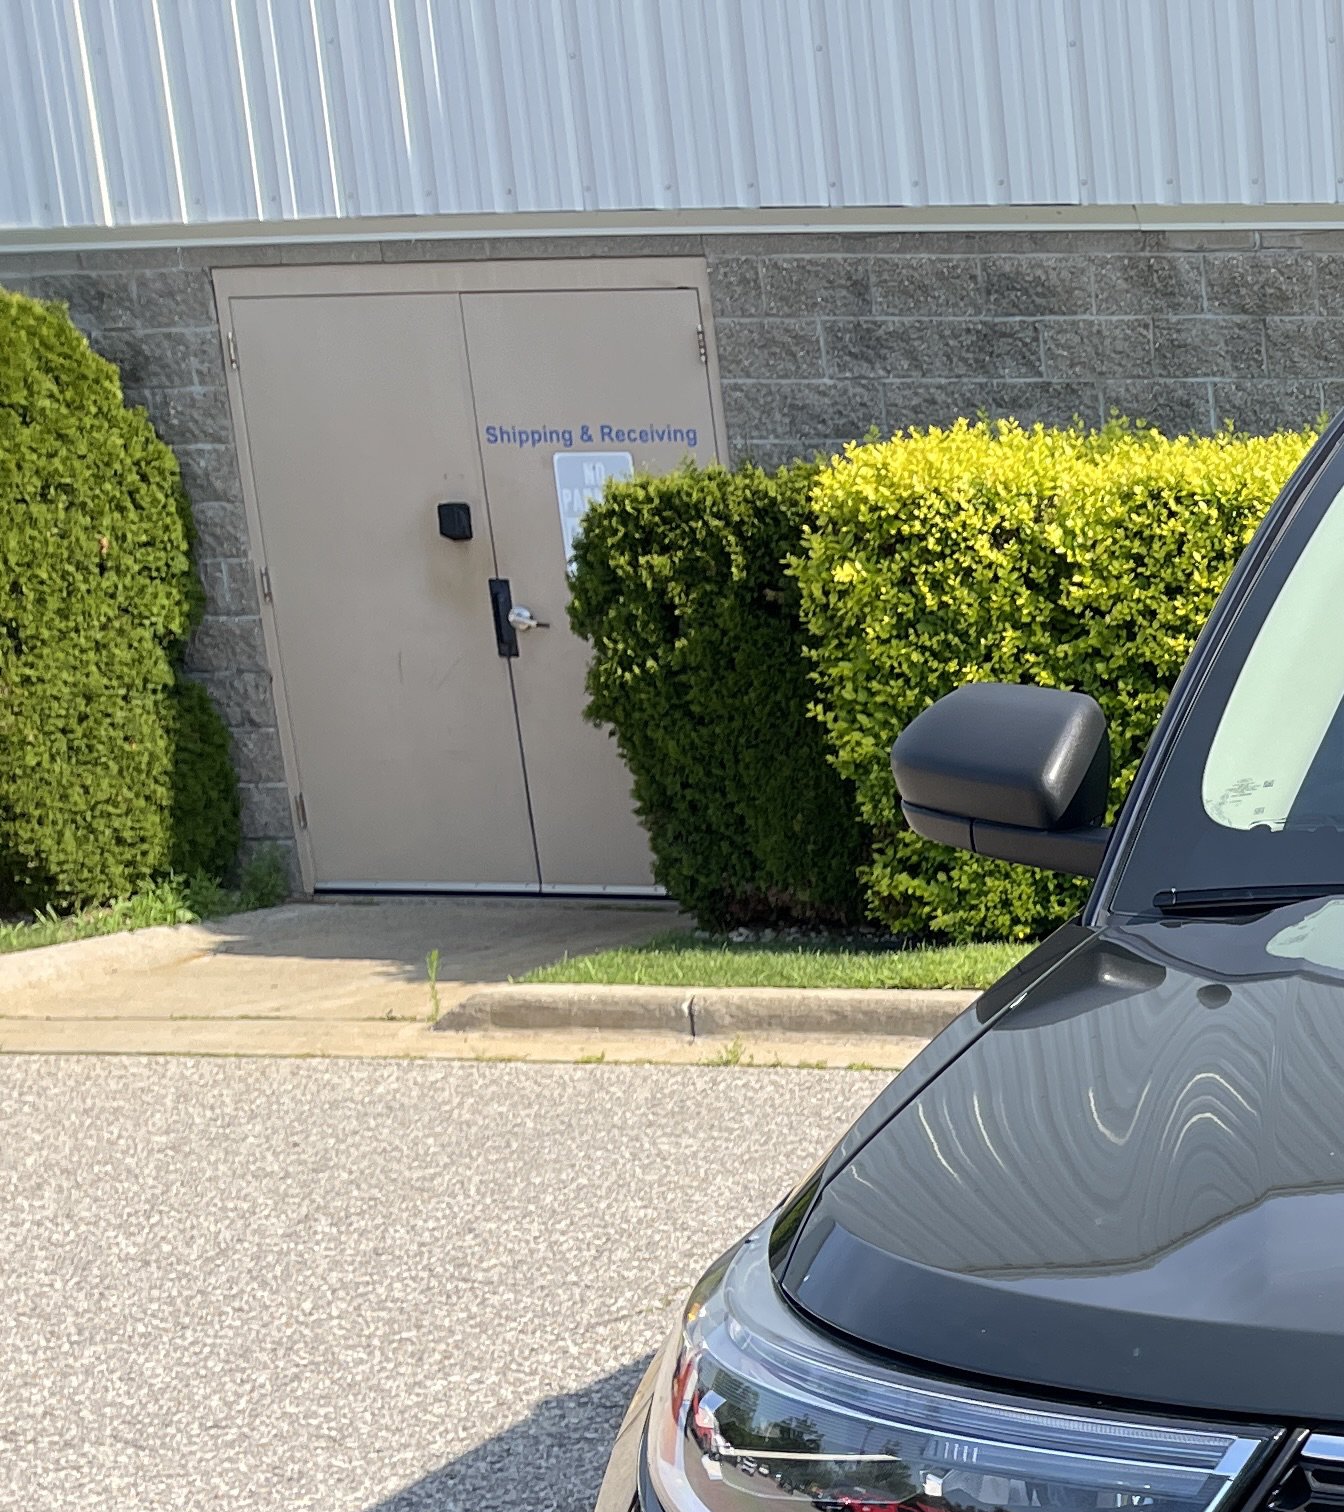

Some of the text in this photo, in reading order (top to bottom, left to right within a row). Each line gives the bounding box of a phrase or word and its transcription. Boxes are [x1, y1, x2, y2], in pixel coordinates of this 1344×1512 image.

[485, 424, 698, 448] Shipping & Receiving
